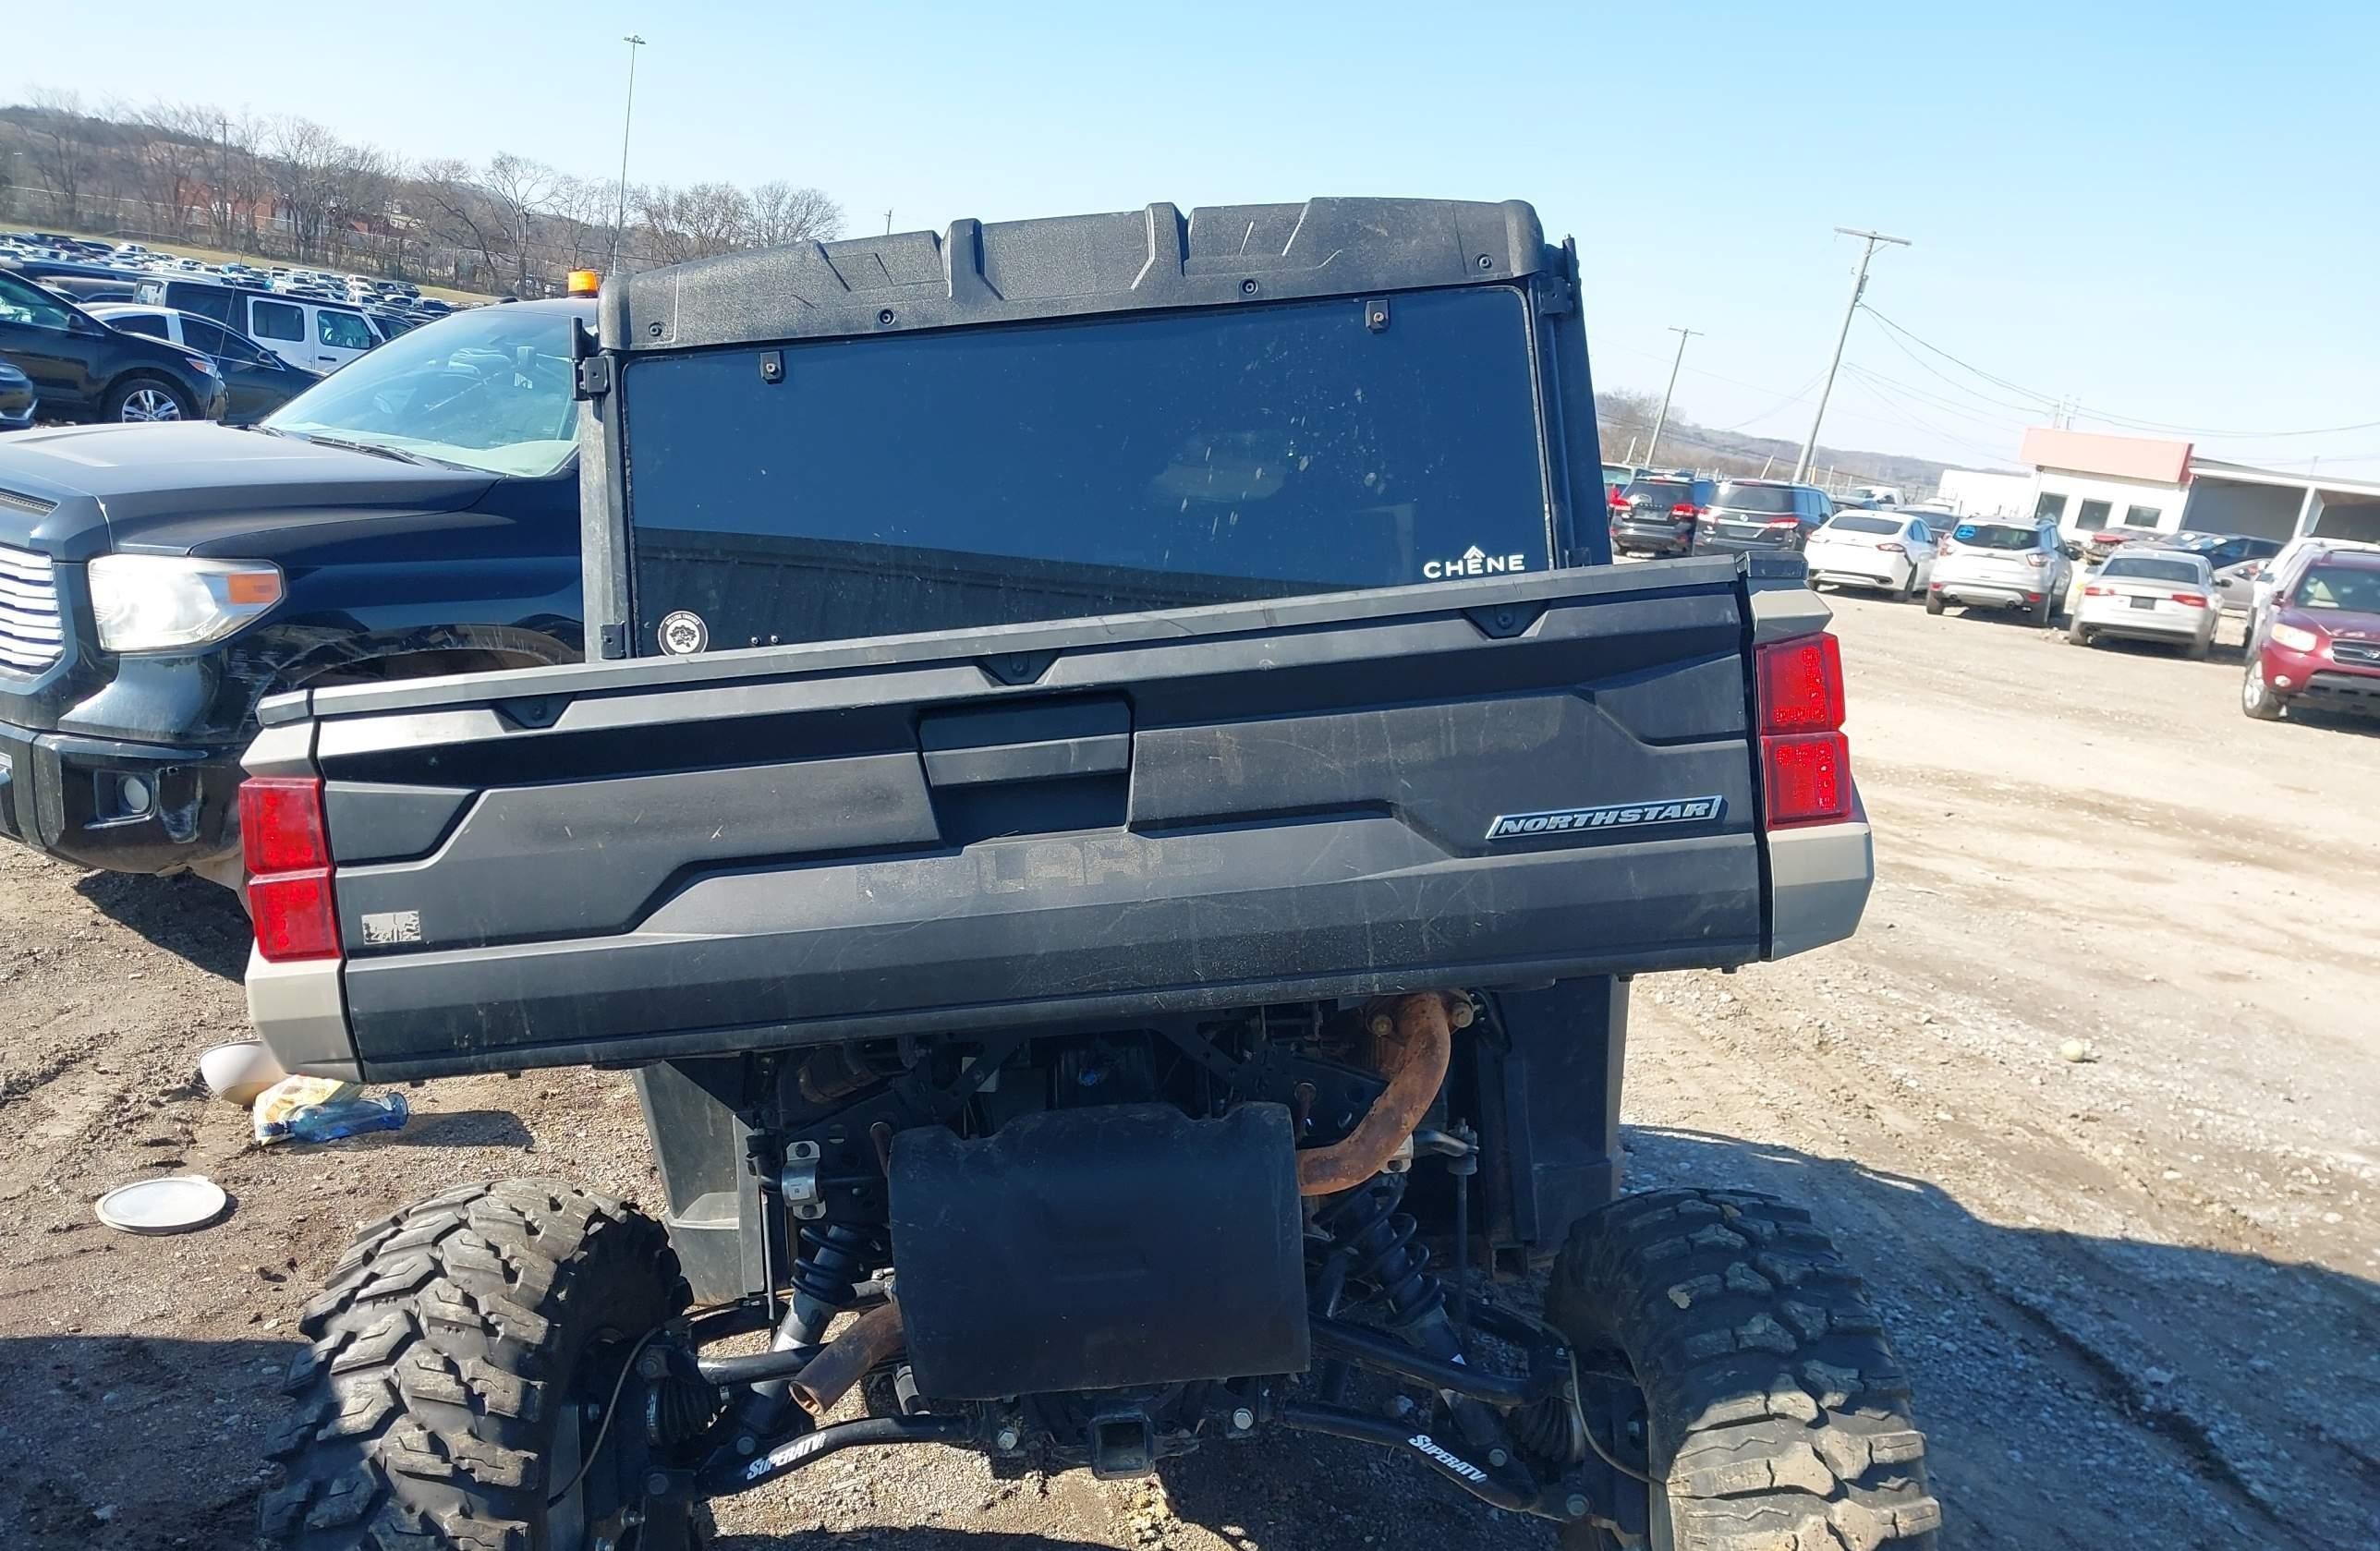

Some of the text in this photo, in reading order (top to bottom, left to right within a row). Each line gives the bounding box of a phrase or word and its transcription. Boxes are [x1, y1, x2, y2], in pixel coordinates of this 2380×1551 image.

[1498, 802, 1709, 835] NORTHSTAR
[856, 839, 1224, 902] LARIS
[747, 1433, 827, 1481] SUPERATV
[1408, 1435, 1488, 1484] SUPERATV
